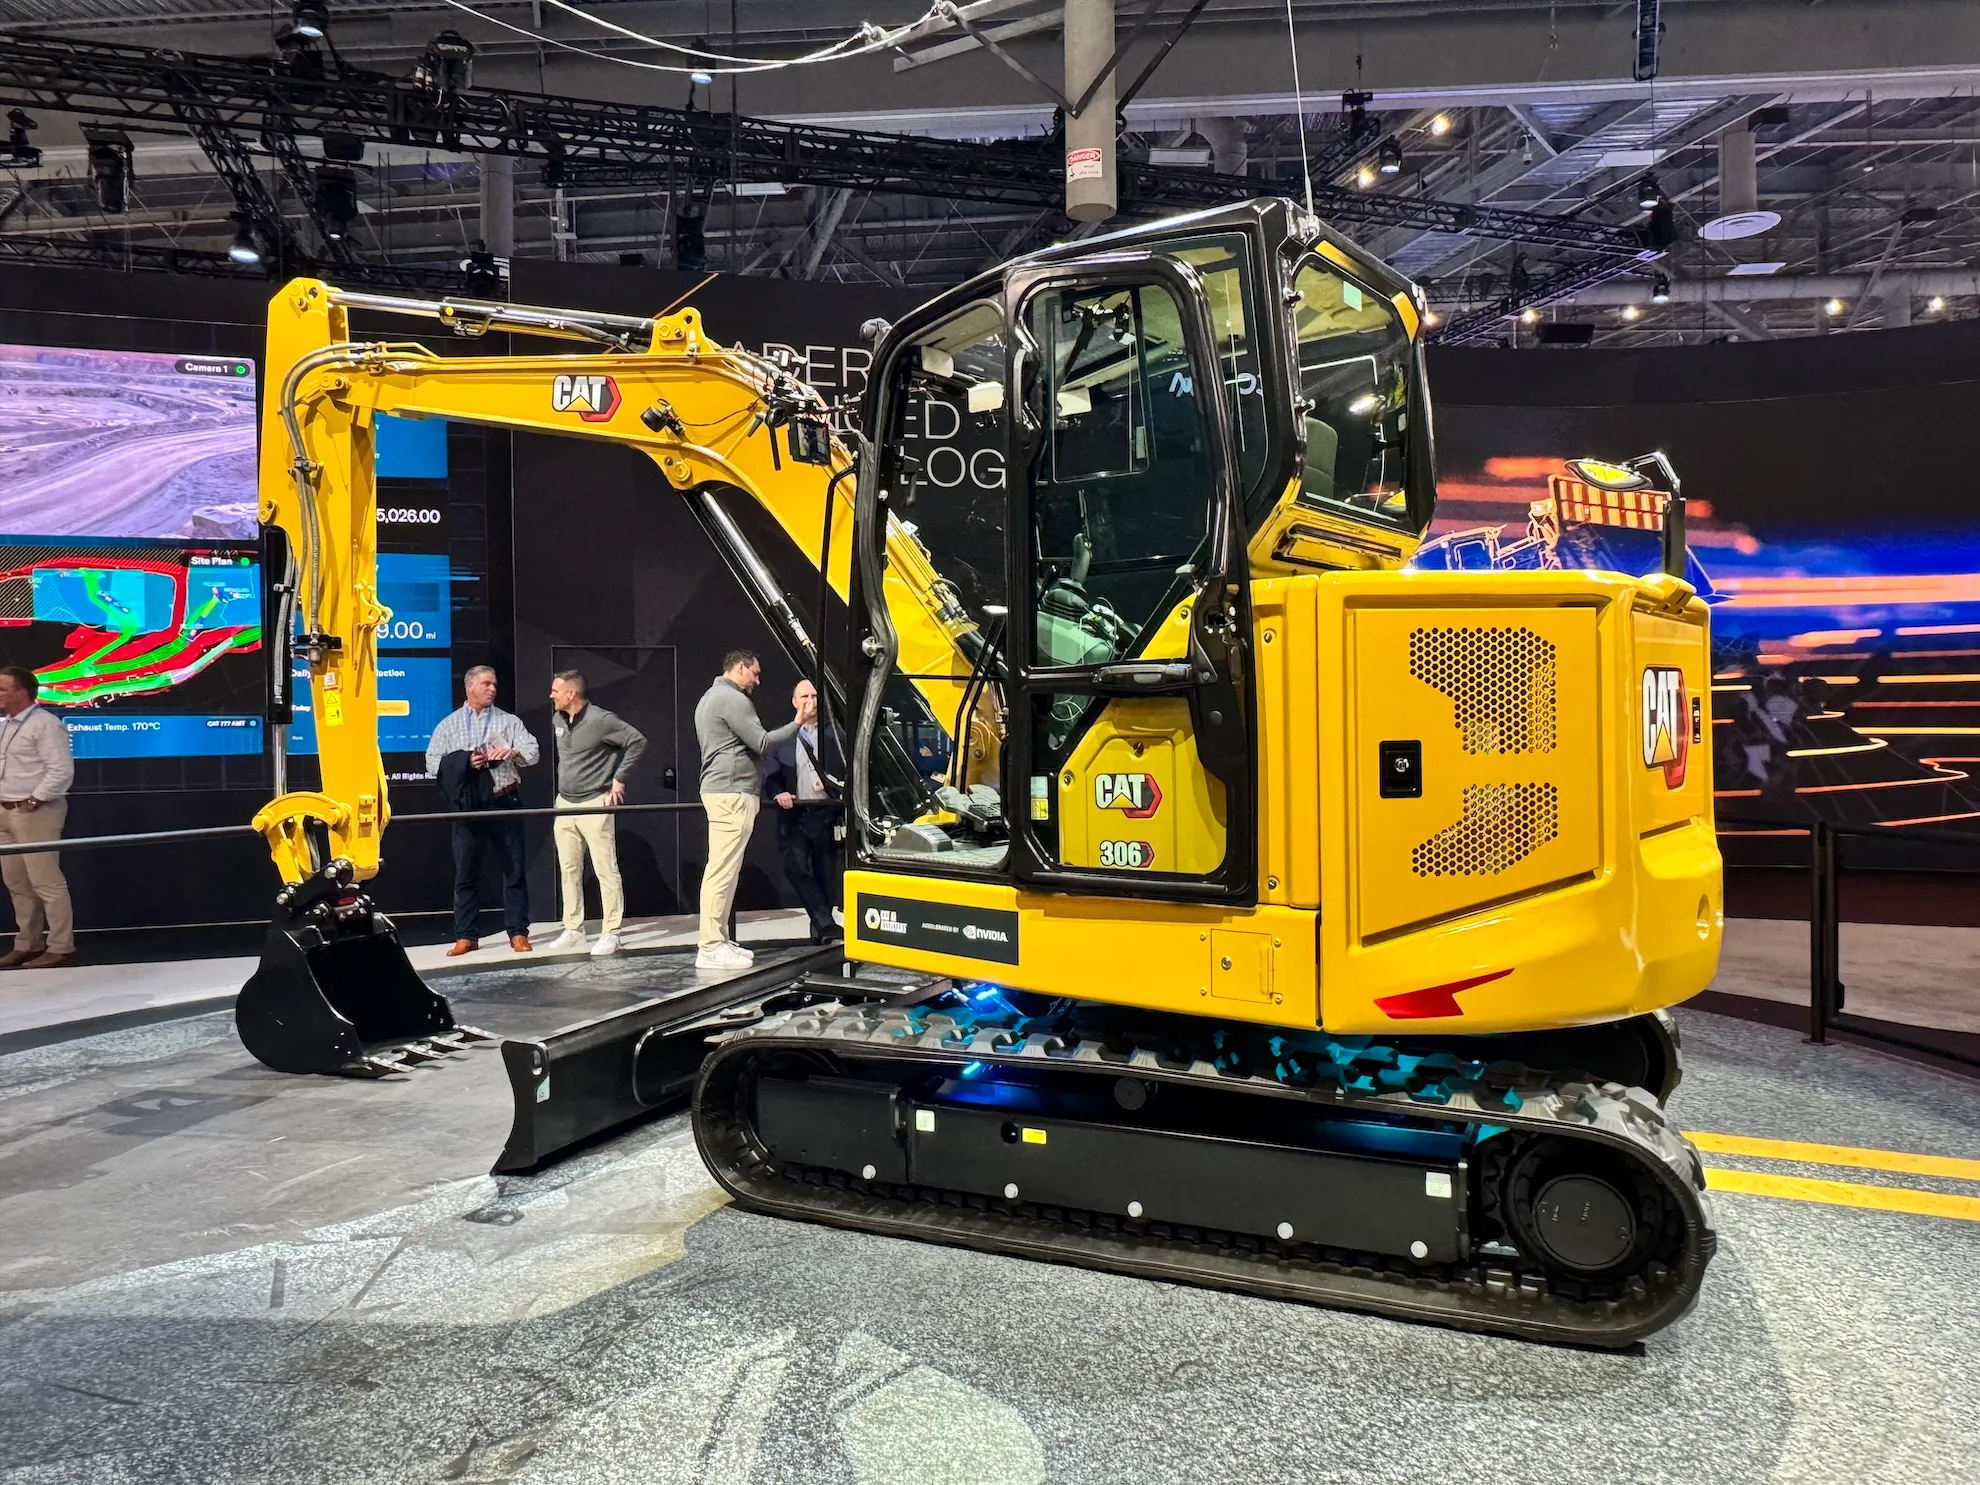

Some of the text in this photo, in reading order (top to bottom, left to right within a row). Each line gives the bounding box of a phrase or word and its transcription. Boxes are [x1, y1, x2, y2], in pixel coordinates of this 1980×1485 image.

[185, 363, 228, 373] Camera 1
[553, 375, 607, 413] CAT
[376, 507, 441, 524] 5,026.00
[191, 556, 233, 565] Site Plan
[1642, 668, 1680, 765] CAT
[67, 723, 102, 732] Exhaust
[105, 723, 129, 733] Temp.
[402, 772, 424, 781] Rights
[1095, 774, 1146, 809] CAT
[1100, 840, 1142, 867] 306
